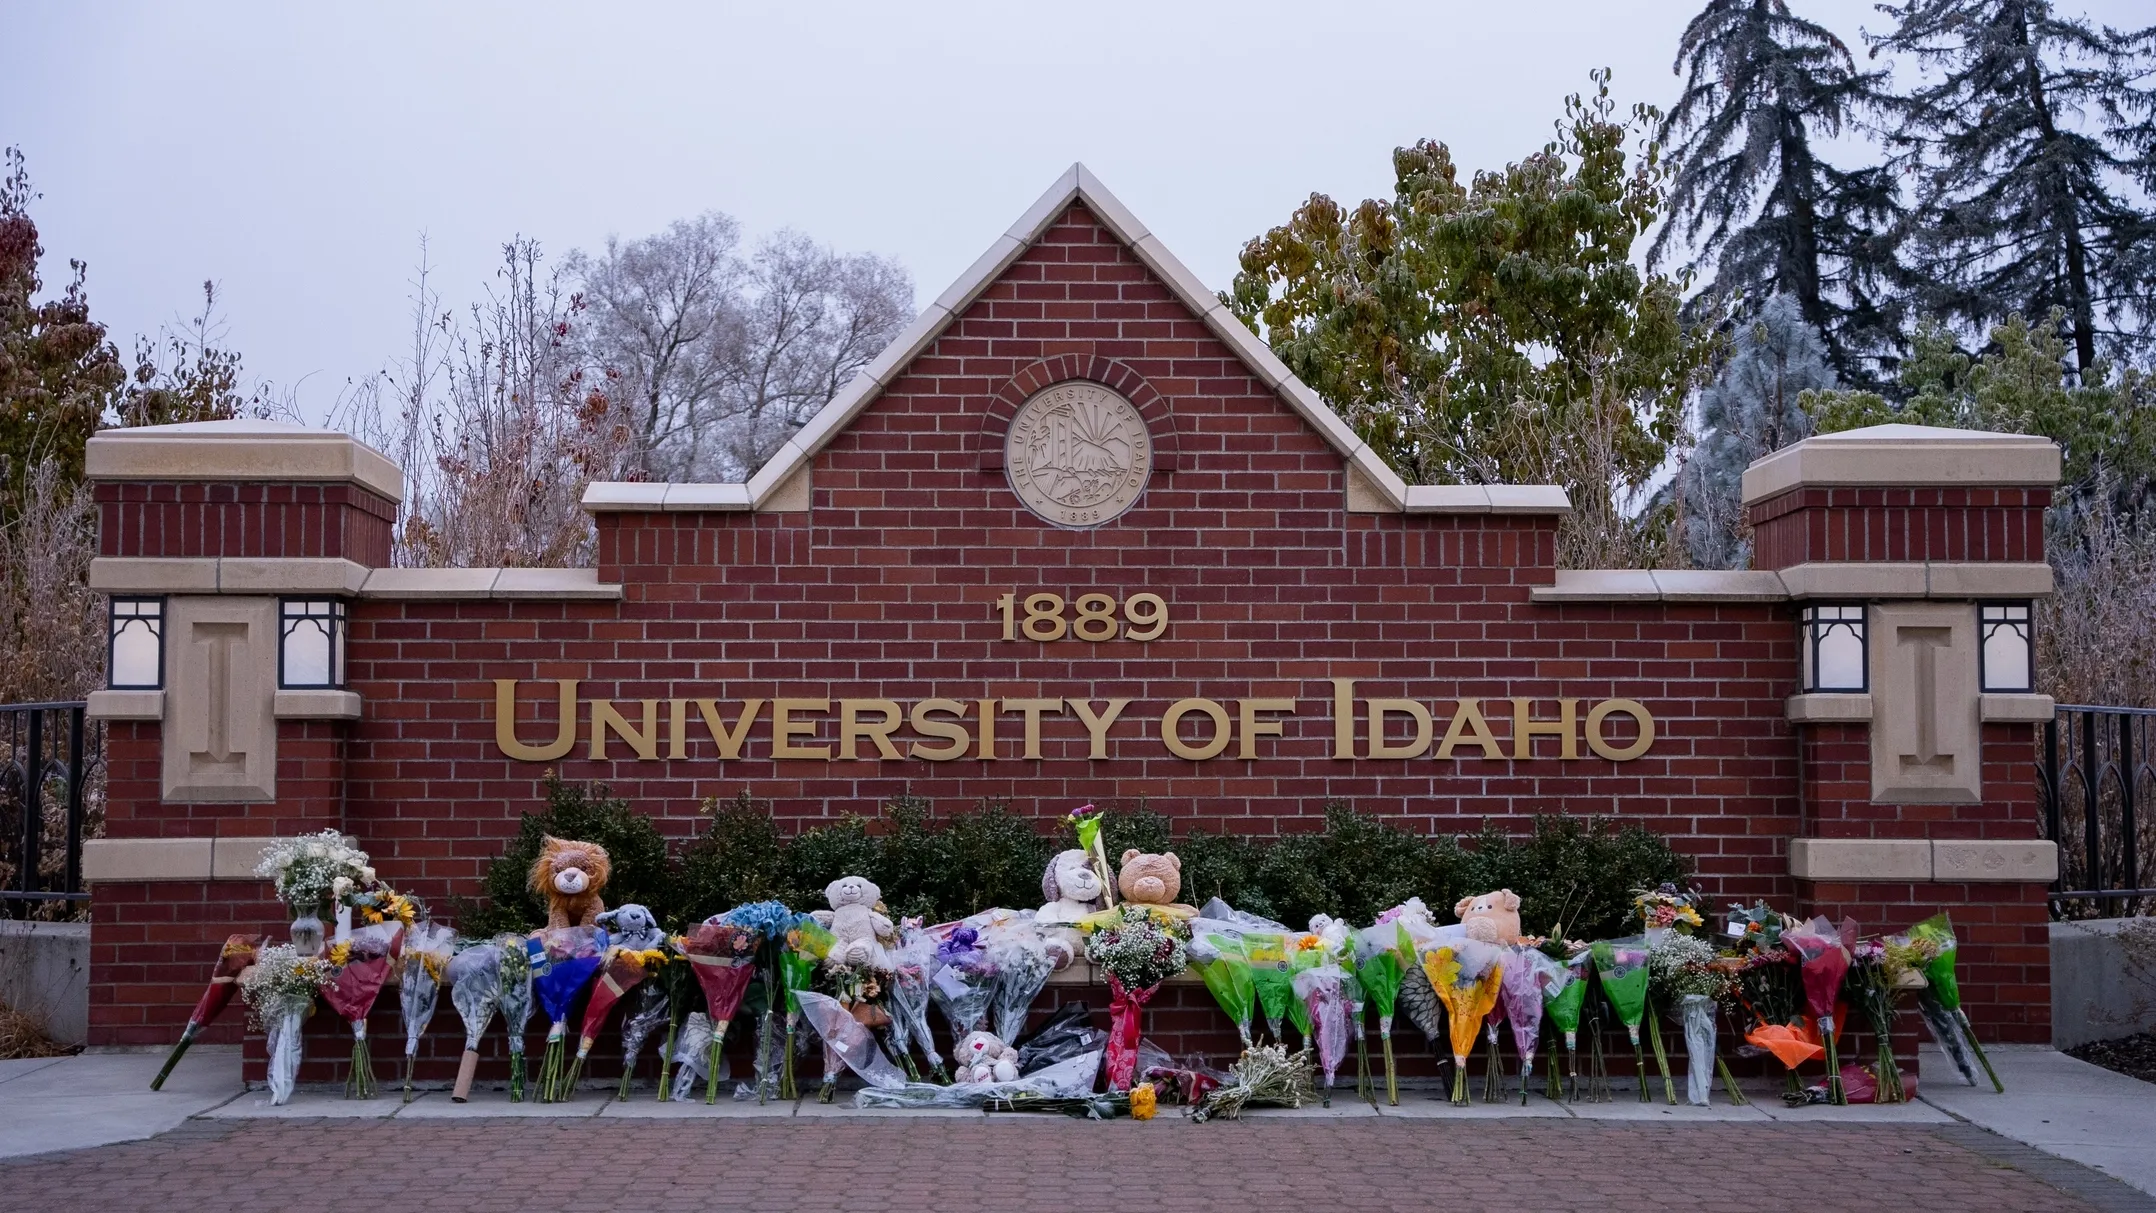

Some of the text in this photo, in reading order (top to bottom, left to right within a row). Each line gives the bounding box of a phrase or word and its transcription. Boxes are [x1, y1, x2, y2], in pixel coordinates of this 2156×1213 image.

[1013, 389, 1146, 489] THE UNIVERSITY OF IDAHO
[1060, 509, 1100, 521] 1889
[997, 592, 1169, 642] 1889
[493, 677, 1655, 762] UNIVERSITY OF IDAHO
